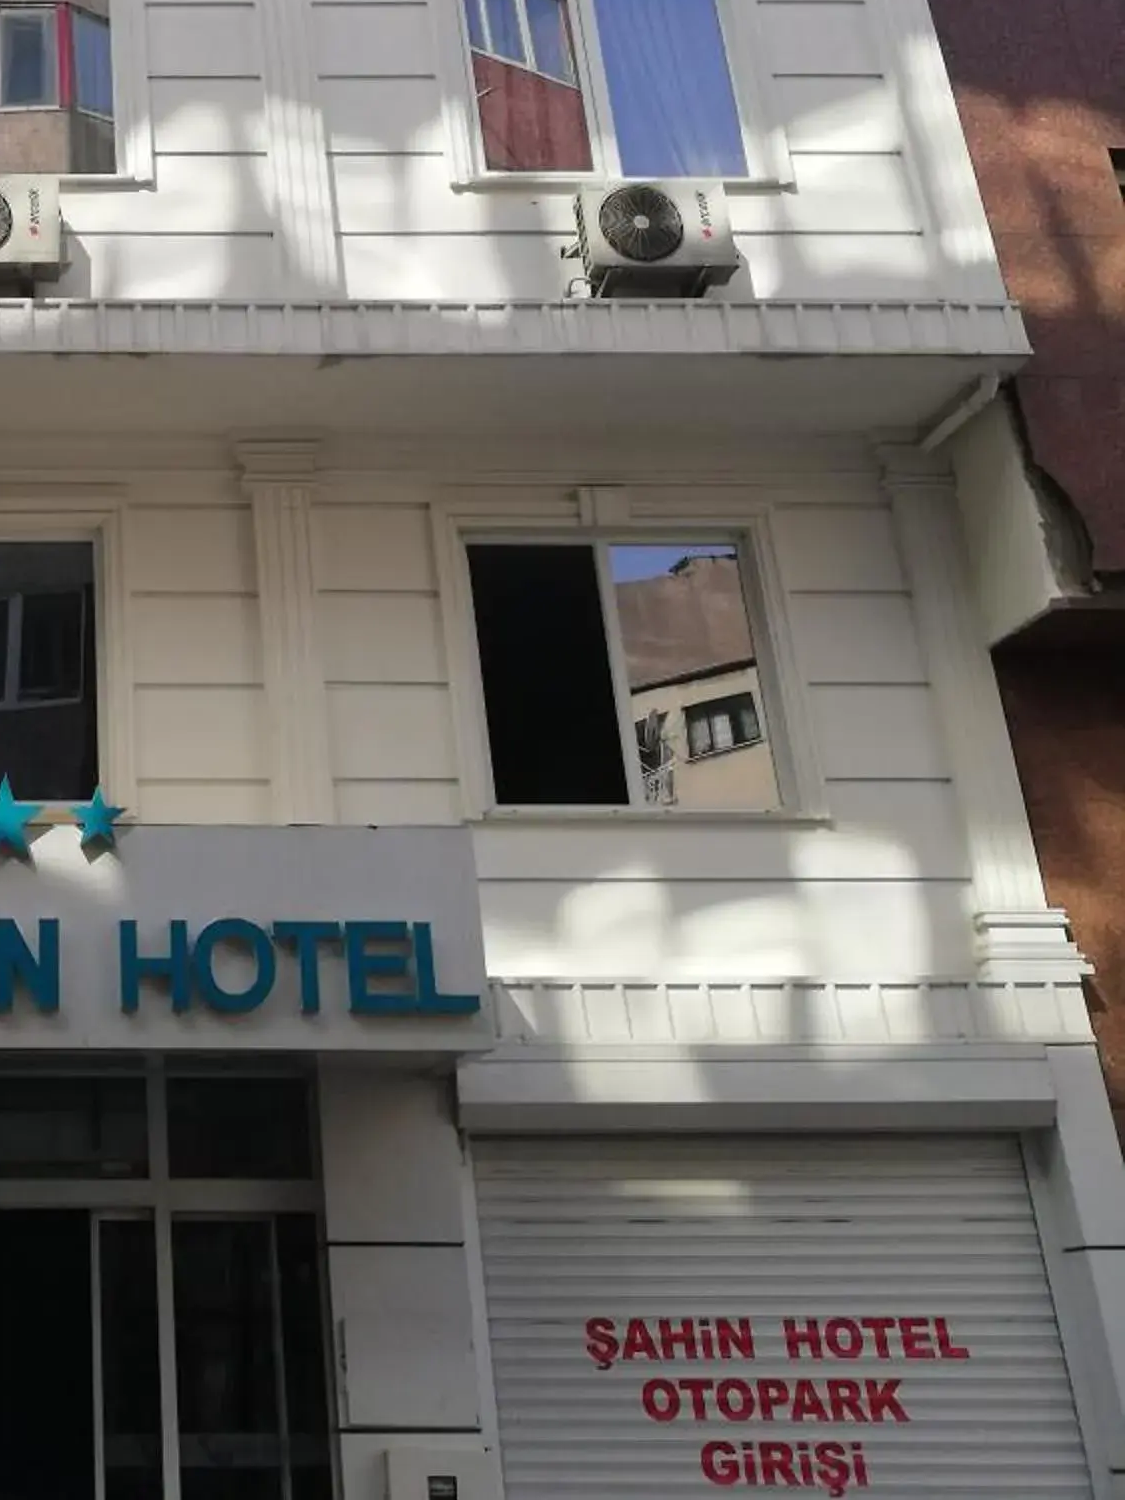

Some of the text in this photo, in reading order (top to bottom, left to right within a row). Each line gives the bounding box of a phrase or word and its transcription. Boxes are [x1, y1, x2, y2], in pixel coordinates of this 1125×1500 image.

[119, 917, 480, 1015] HOTEL
[784, 1317, 971, 1360] HOTEL
[641, 1378, 909, 1423] OTOPARK
